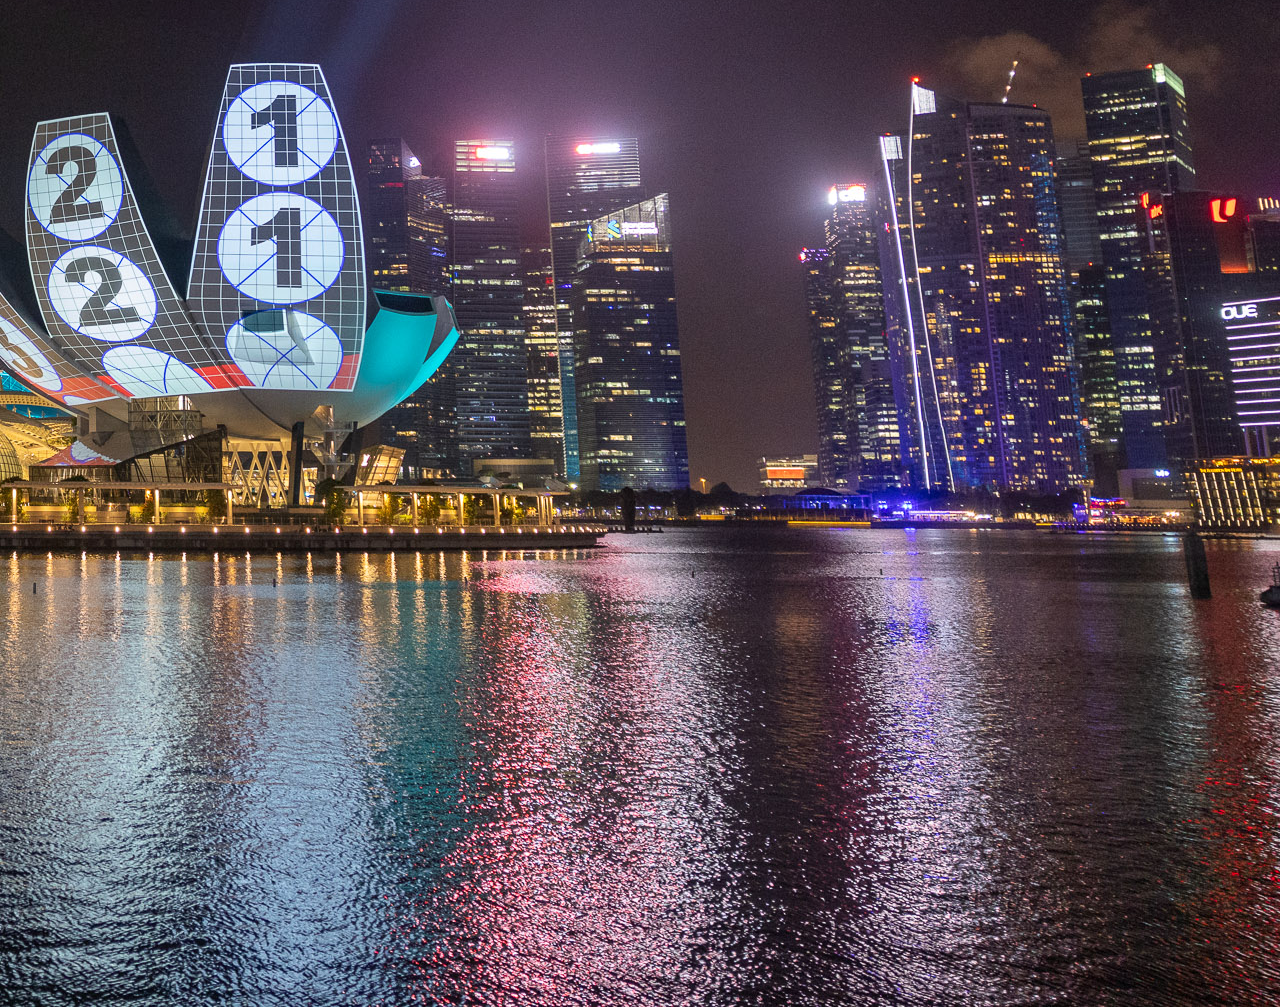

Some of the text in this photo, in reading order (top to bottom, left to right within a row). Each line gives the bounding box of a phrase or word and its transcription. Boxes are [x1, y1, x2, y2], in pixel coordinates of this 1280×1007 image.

[251, 94, 297, 168] 1
[45, 145, 107, 223] 2
[250, 207, 302, 288] 1
[64, 256, 138, 327] 2
